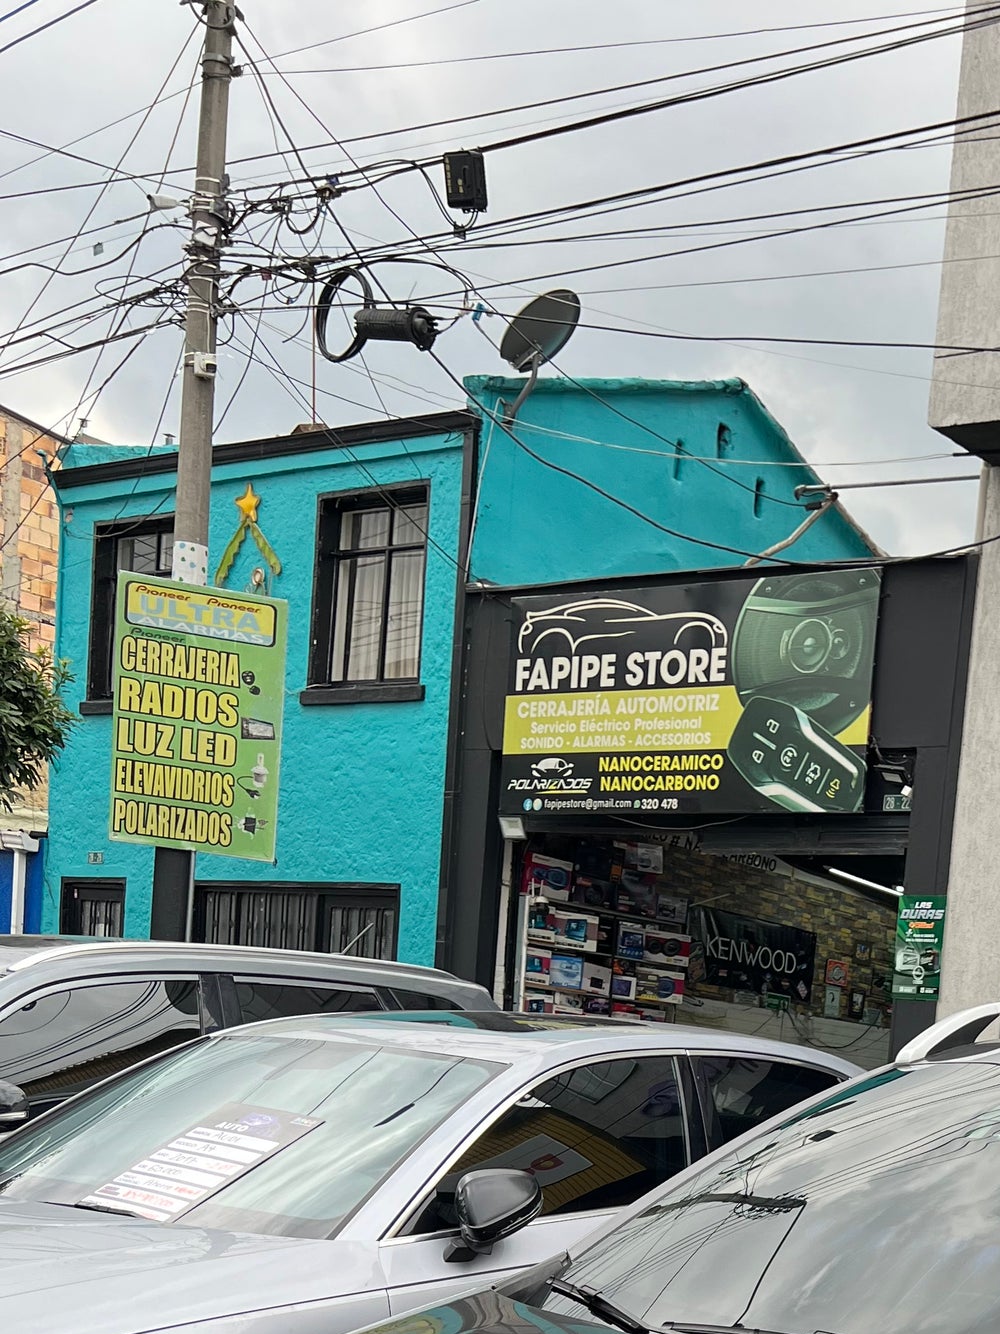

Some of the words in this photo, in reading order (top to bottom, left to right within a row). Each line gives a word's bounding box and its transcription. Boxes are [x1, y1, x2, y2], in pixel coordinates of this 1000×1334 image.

[135, 585, 191, 602] Pioneer
[206, 597, 261, 614] Pioneer
[140, 594, 260, 632] ULTRA
[130, 627, 185, 644] Pioneer
[133, 615, 265, 644] ALARMAS
[121, 635, 240, 689] CERRAJERIA
[515, 653, 617, 691] FAPIPE
[625, 647, 728, 687] STORE
[118, 676, 240, 729] RADIOS
[517, 694, 611, 719] CERRAJERÍA
[615, 693, 720, 715] AUTOMOTRIZ
[531, 721, 577, 734] Servicio
[579, 718, 631, 732] Eléctrico
[634, 715, 702, 731] Profesional
[116, 717, 175, 759] LUZ
[180, 726, 237, 767] LED
[520, 736, 564, 749] SONIDO
[572, 734, 626, 748] ALARMAS
[635, 732, 711, 746] ACCESORIOS
[598, 753, 724, 772] NANOCERAMICO
[115, 757, 234, 808] ELEVAVIDRIOS
[507, 777, 593, 791] POLARIZADOS
[600, 774, 720, 792] NANOCARBONO
[544, 798, 632, 810] fapipestore@gmail.com
[641, 798, 659, 810] 320
[660, 798, 678, 810] 478
[112, 798, 233, 847] POLARIZADOS
[900, 909, 945, 920] DURAS
[914, 901, 933, 909] LAS
[706, 934, 797, 974] KENWOOD
